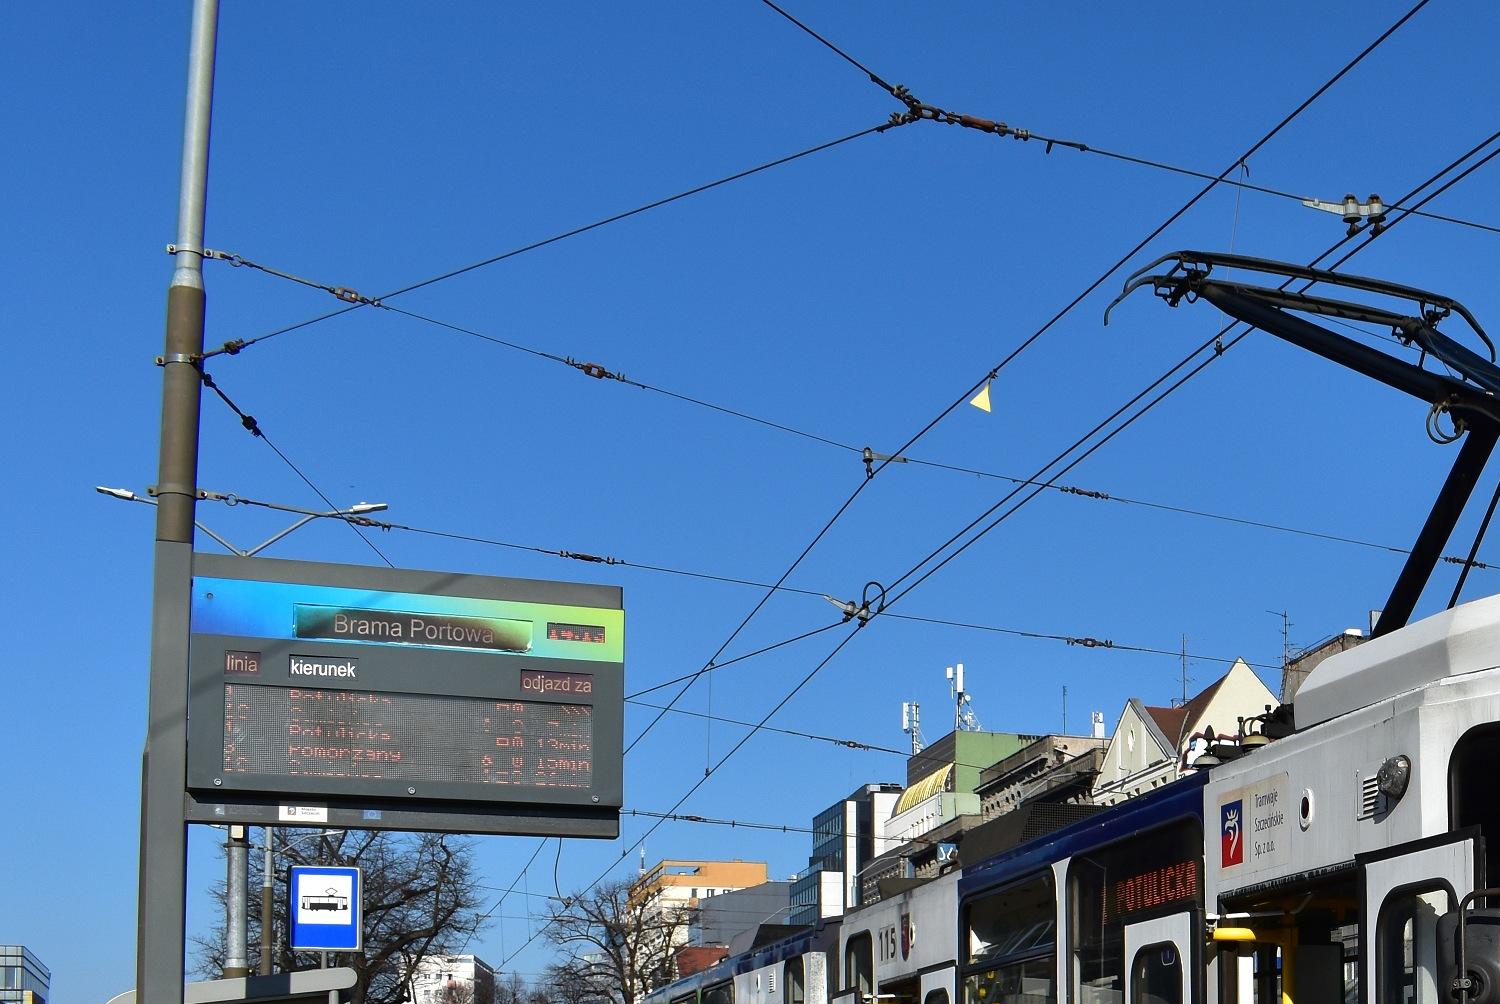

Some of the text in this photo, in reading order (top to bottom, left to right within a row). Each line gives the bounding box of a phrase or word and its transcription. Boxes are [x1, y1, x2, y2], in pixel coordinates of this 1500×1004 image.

[334, 613, 494, 644] Brama Portowa
[226, 654, 356, 678] linia kierunek
[523, 675, 592, 693] odjazd za
[1255, 788, 1278, 808] Tramwaje
[1115, 860, 1197, 914] POTULICKA
[879, 927, 896, 961] 115
